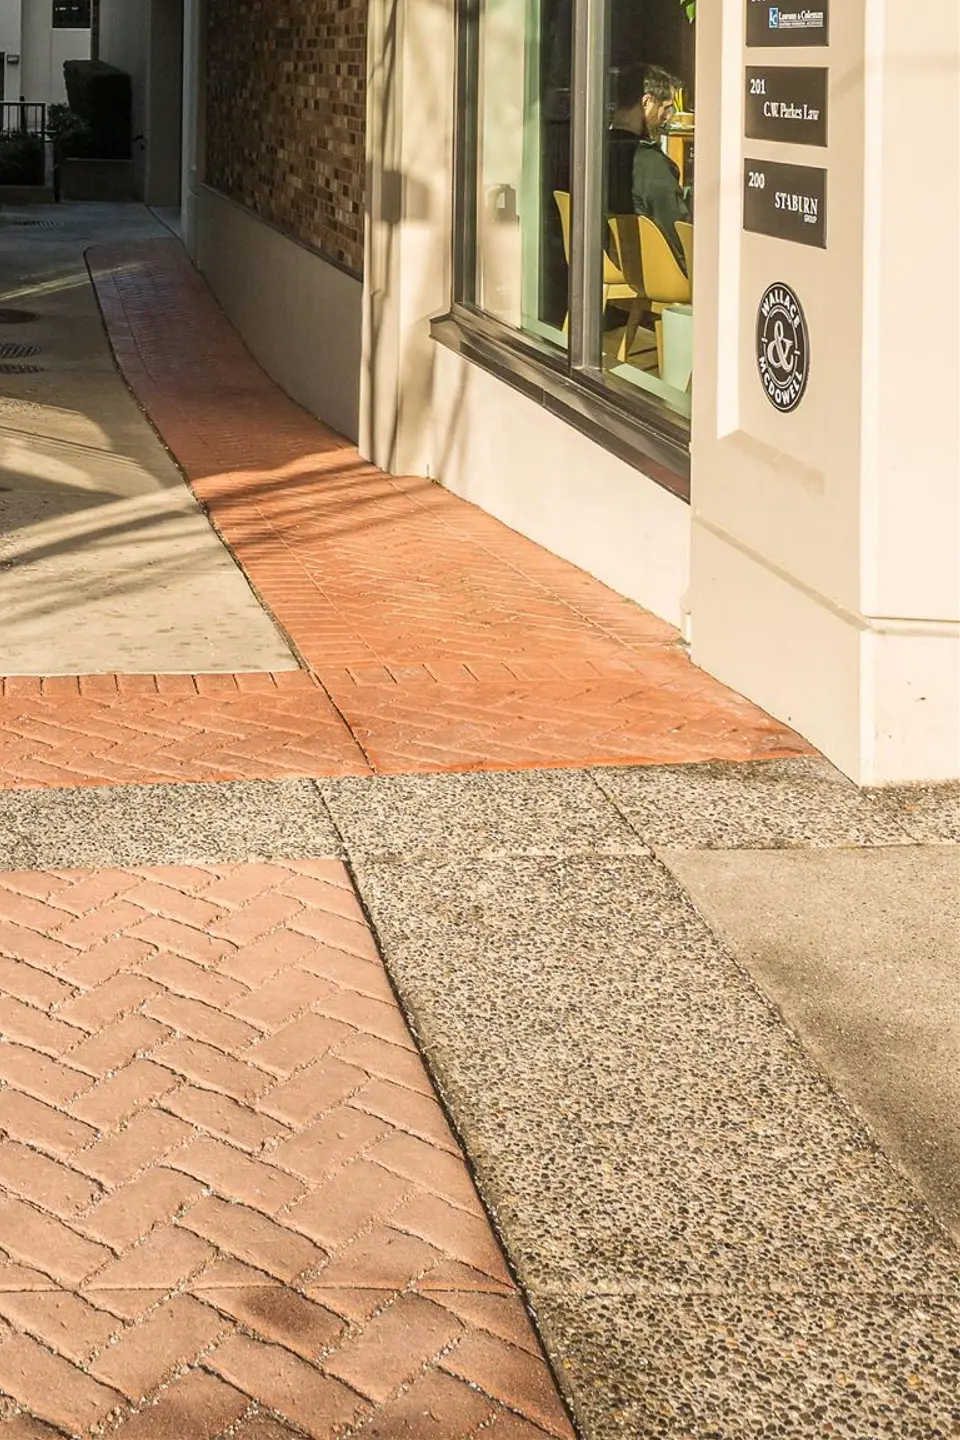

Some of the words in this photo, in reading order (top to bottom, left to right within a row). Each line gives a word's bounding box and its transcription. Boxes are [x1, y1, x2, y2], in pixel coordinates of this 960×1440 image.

[750, 78, 766, 94] 201
[803, 104, 819, 121] Law
[748, 171, 765, 189] 200
[761, 289, 800, 328] WALLACE
[767, 320, 794, 373] &
